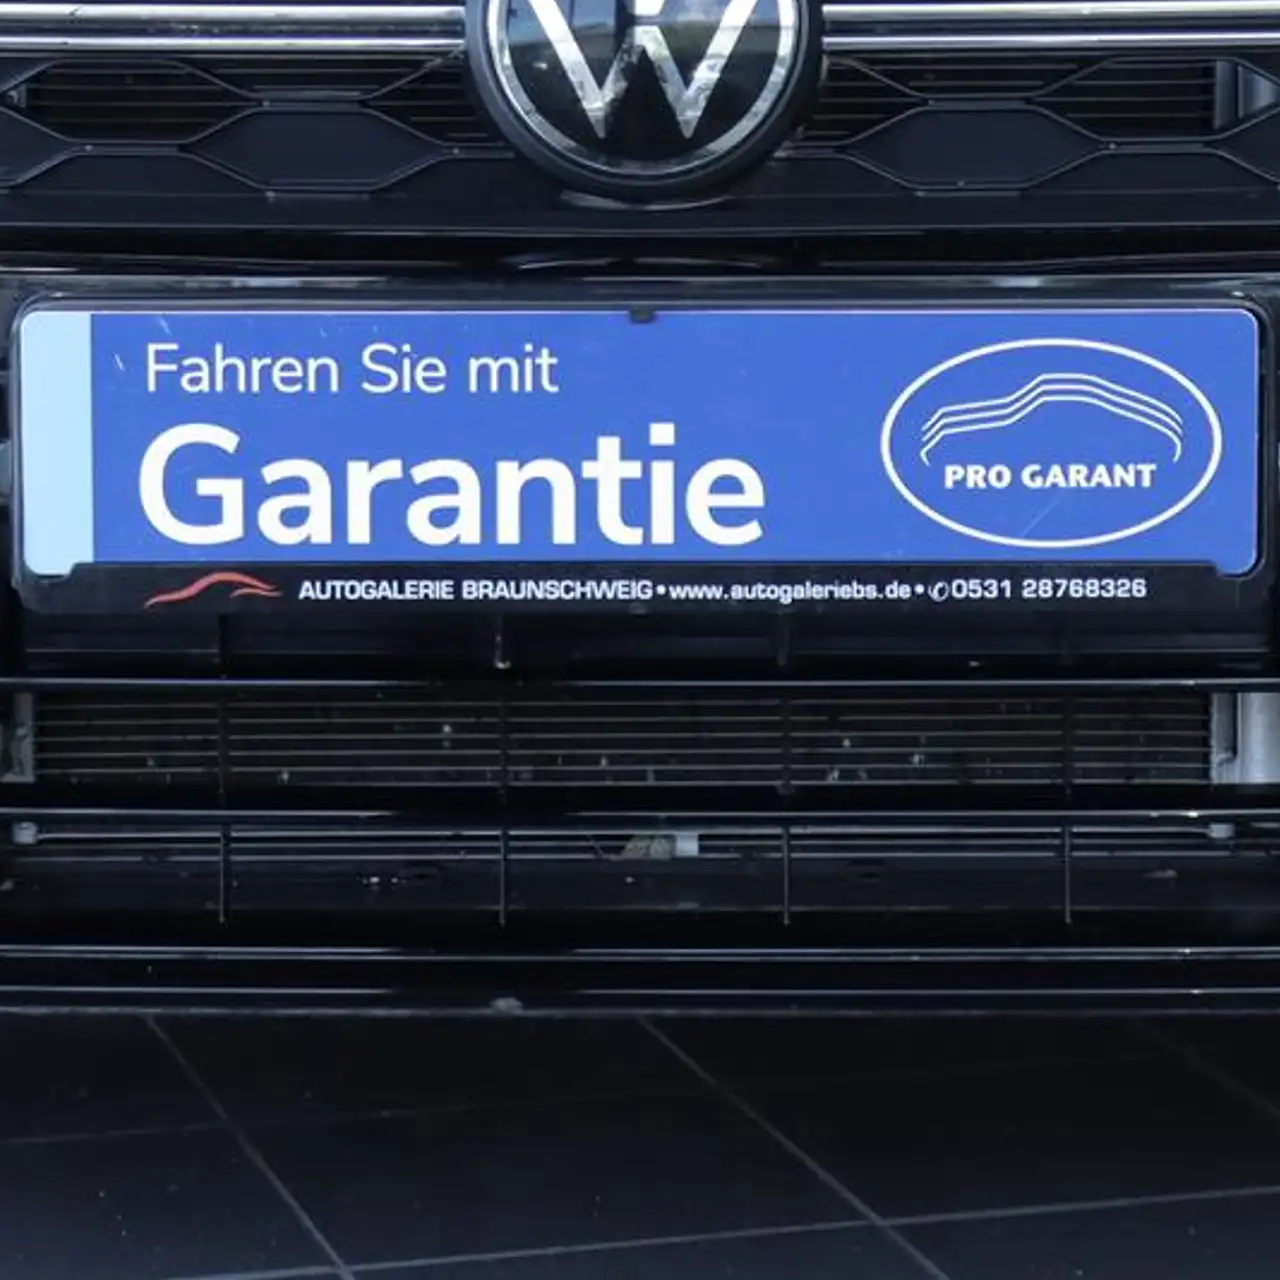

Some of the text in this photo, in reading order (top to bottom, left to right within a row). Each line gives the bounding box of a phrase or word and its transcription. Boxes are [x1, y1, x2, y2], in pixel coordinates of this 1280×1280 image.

[145, 341, 560, 394] Fahren Sie mit
[137, 421, 766, 547] Garantie
[943, 463, 1158, 490] PRO GARANT
[297, 577, 1148, 605] AUTOGALERIE BRAUNSCHWEIG www.autogaleriebs.de 0531 28768326
